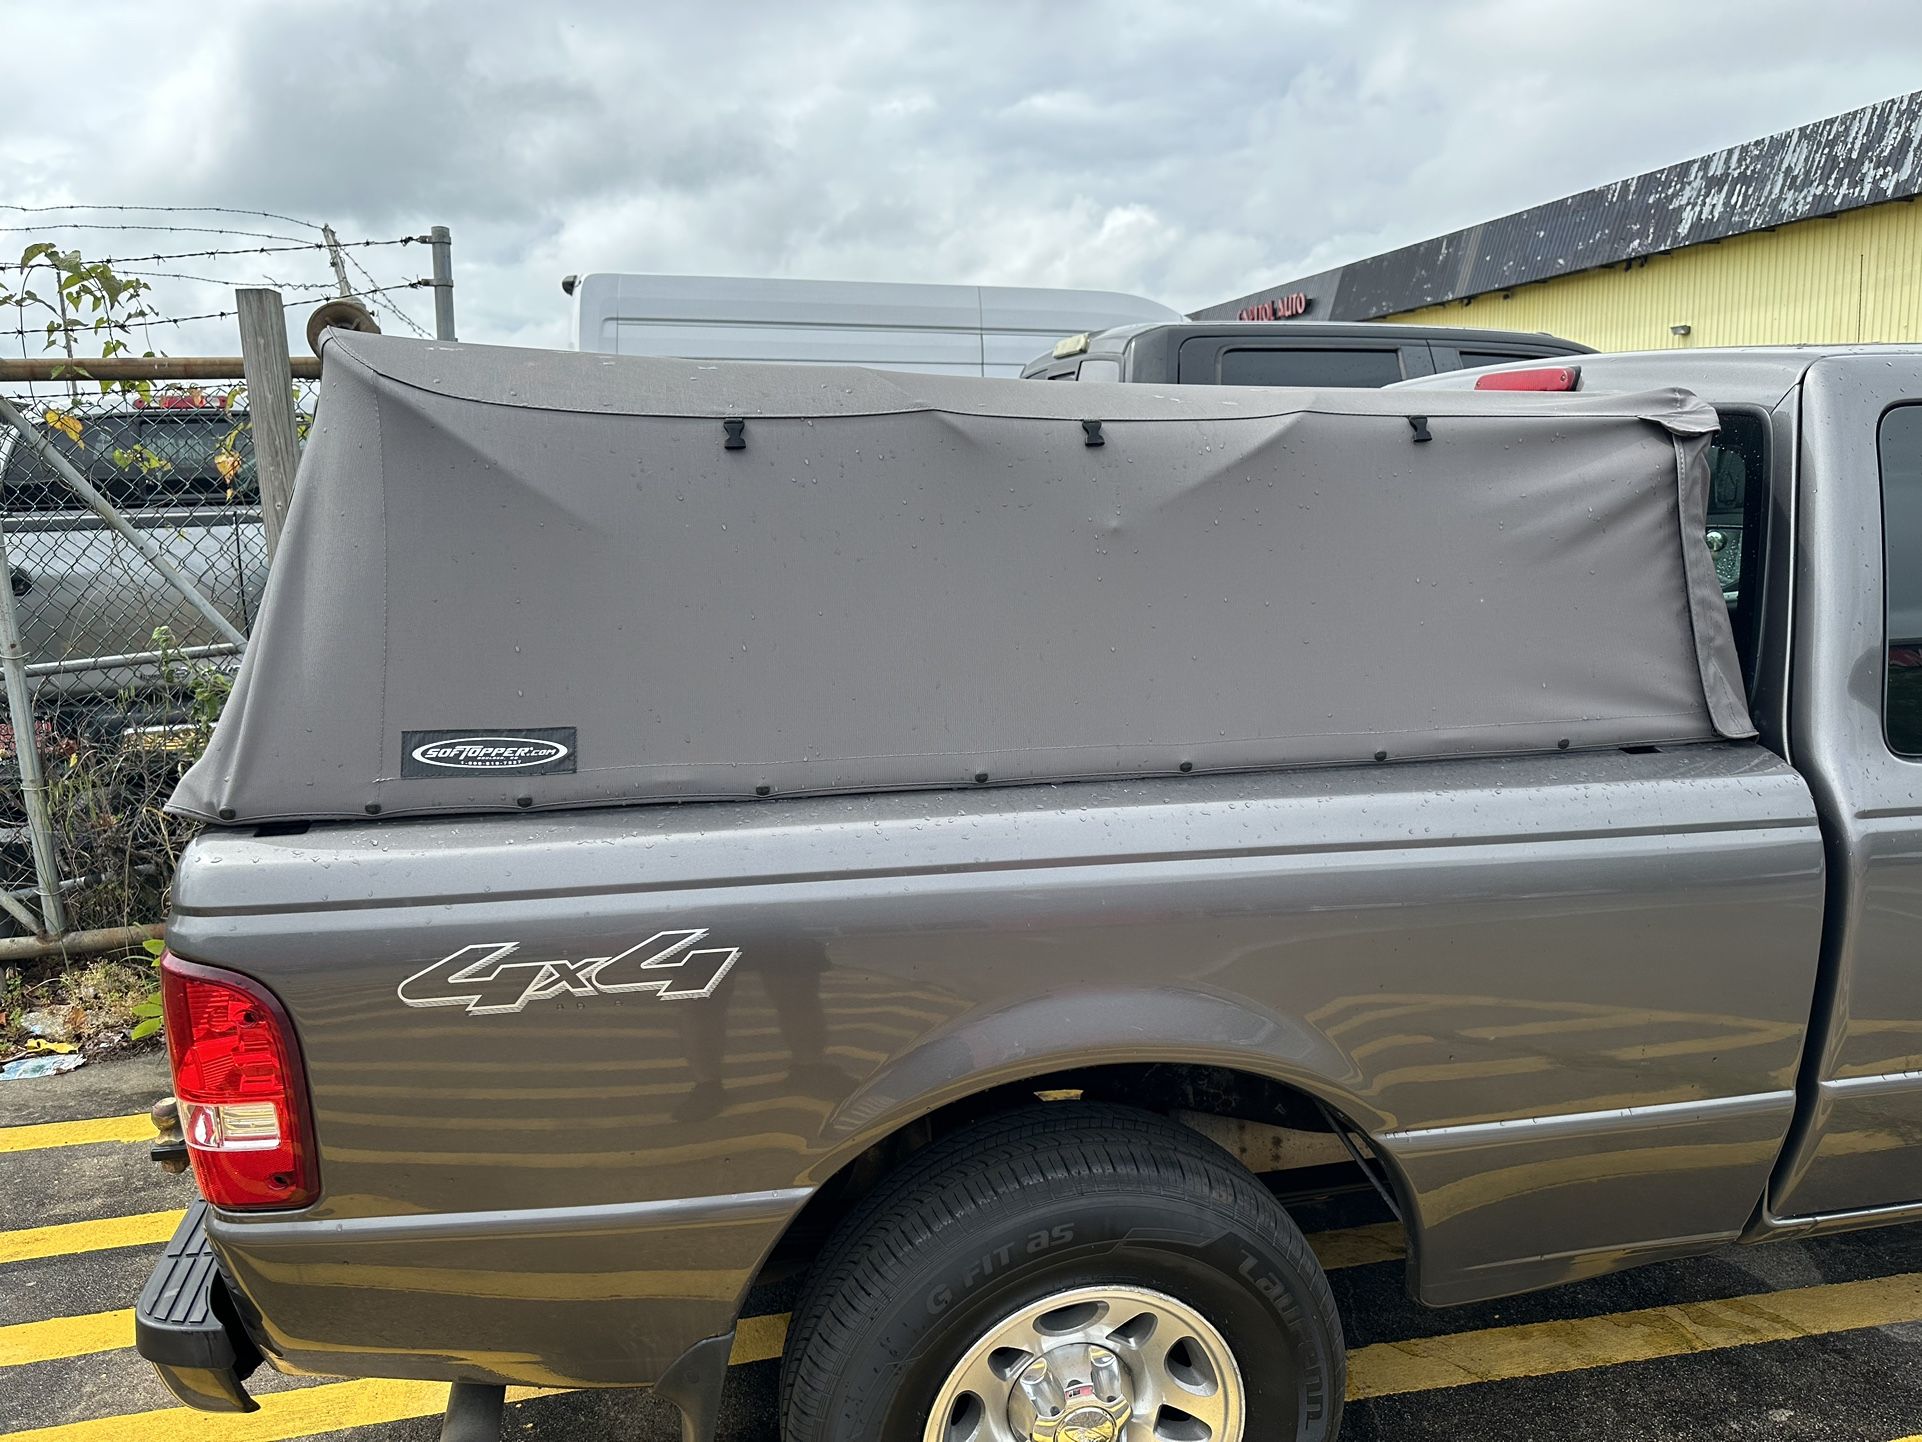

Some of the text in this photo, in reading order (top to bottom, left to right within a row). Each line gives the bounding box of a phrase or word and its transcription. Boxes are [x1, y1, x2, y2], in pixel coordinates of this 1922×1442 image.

[1278, 292, 1306, 318] AUTO
[925, 1283, 953, 1315] G
[963, 1241, 1017, 1289] FIT
